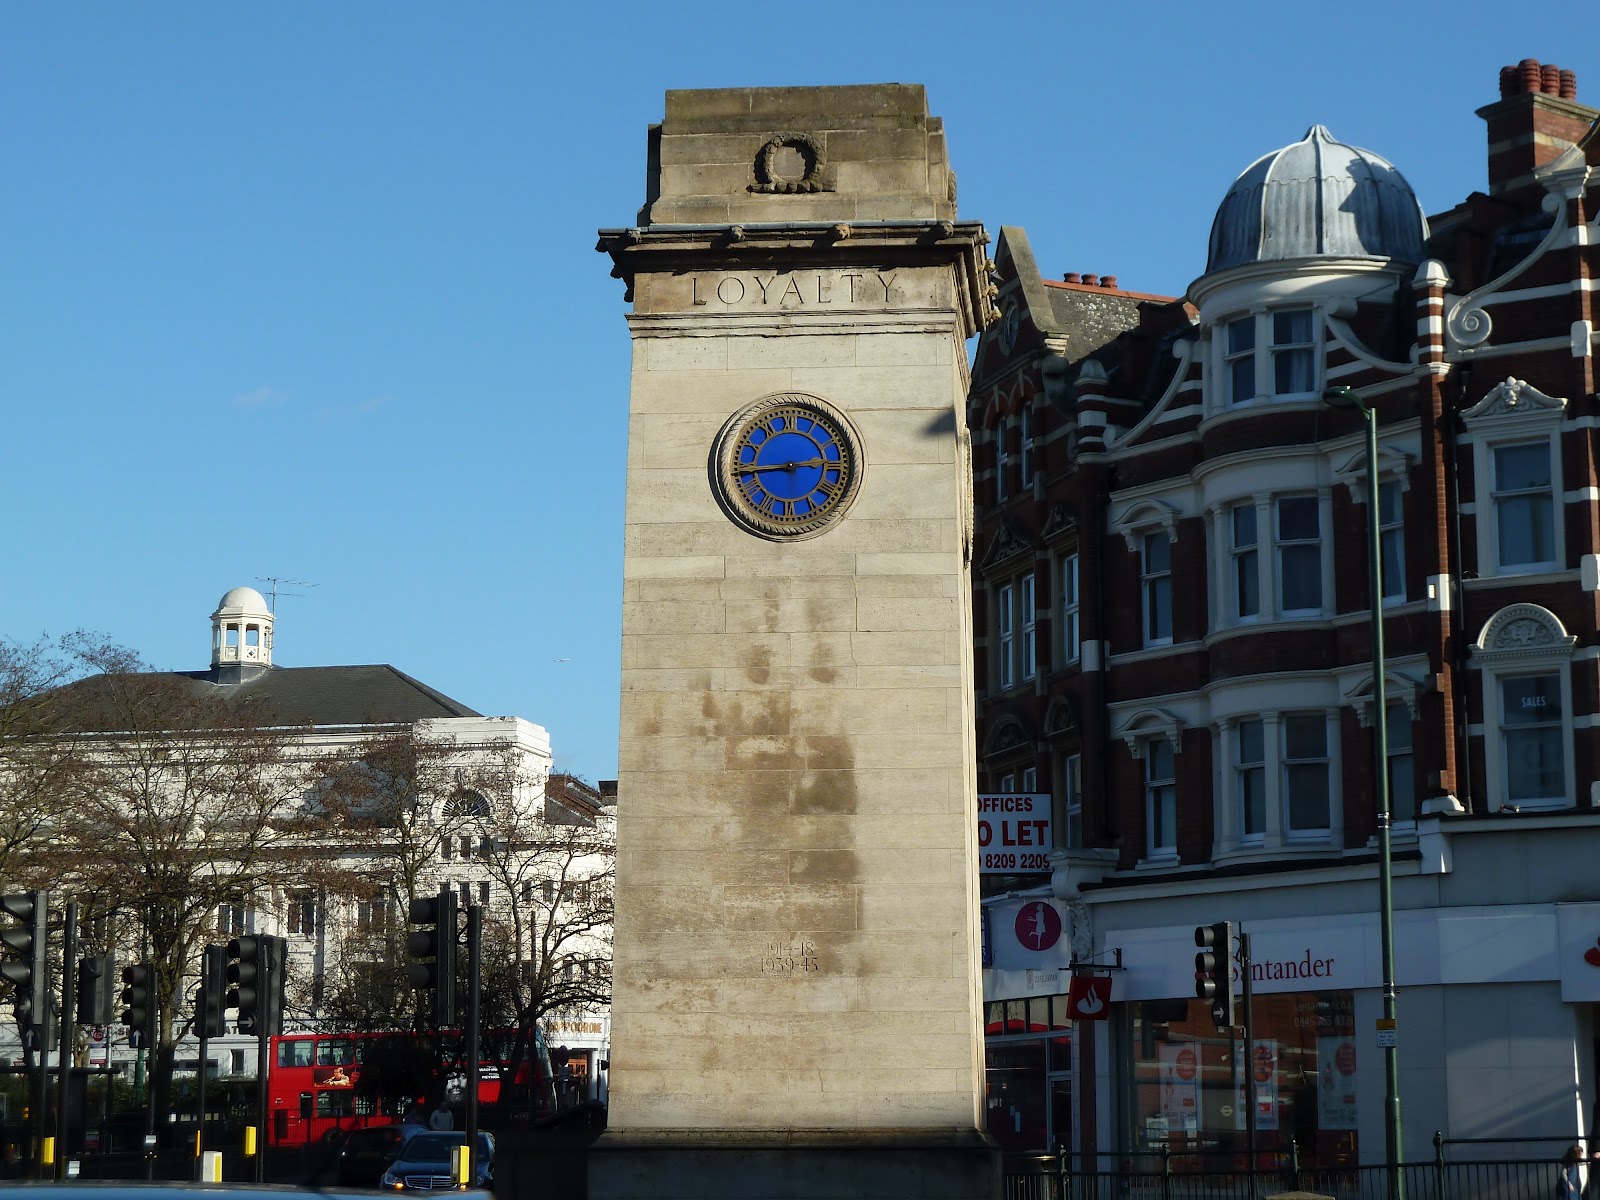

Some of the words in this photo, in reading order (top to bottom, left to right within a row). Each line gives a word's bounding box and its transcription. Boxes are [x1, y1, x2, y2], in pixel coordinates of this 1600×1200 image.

[692, 273, 897, 306] LOYALTY
[1521, 696, 1546, 708] SALES
[978, 820, 993, 847] O
[1002, 820, 1049, 847] LET
[985, 853, 1016, 869] 8209
[767, 942, 814, 957] 1914-18
[761, 957, 818, 973] 1939-45
[1232, 949, 1335, 982] ntander
